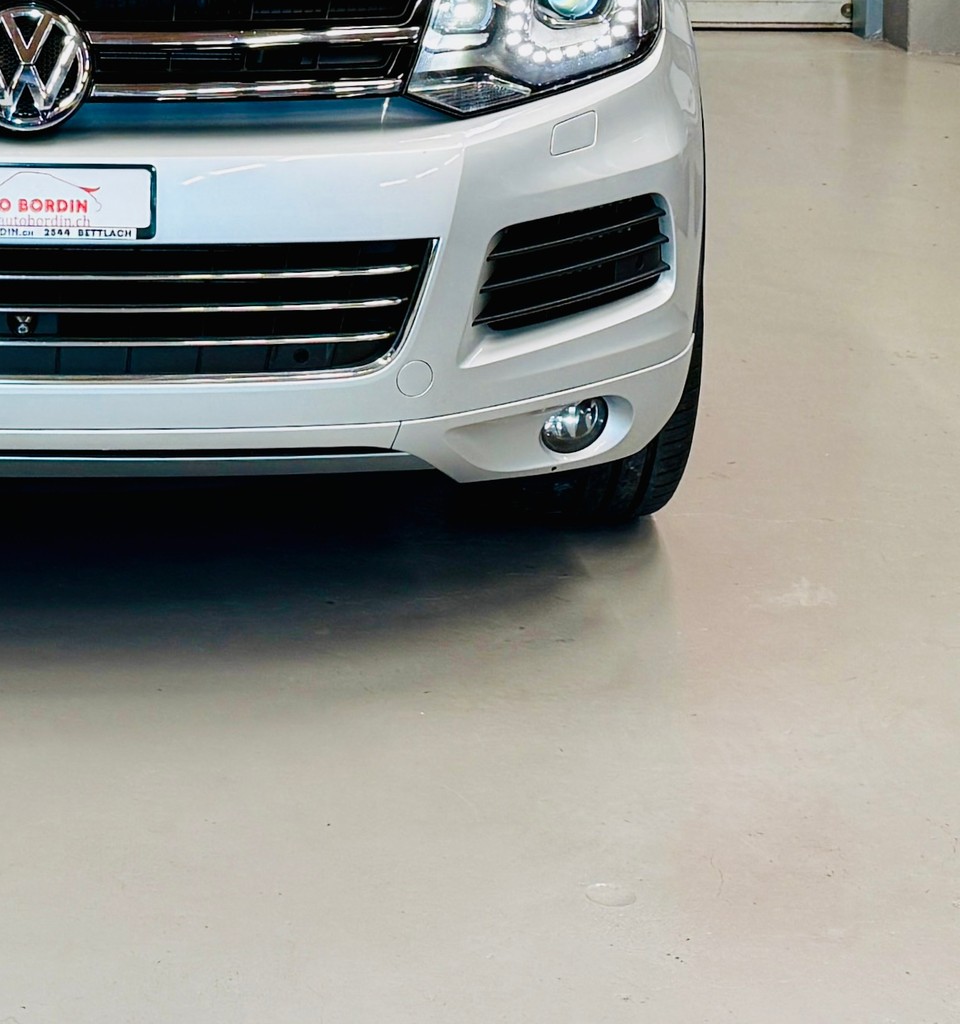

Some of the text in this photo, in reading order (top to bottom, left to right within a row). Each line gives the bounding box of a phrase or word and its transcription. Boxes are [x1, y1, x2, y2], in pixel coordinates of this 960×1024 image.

[18, 198, 88, 213] BORDIN
[44, 228, 71, 237] 2544
[78, 228, 132, 237] BETTLACH
